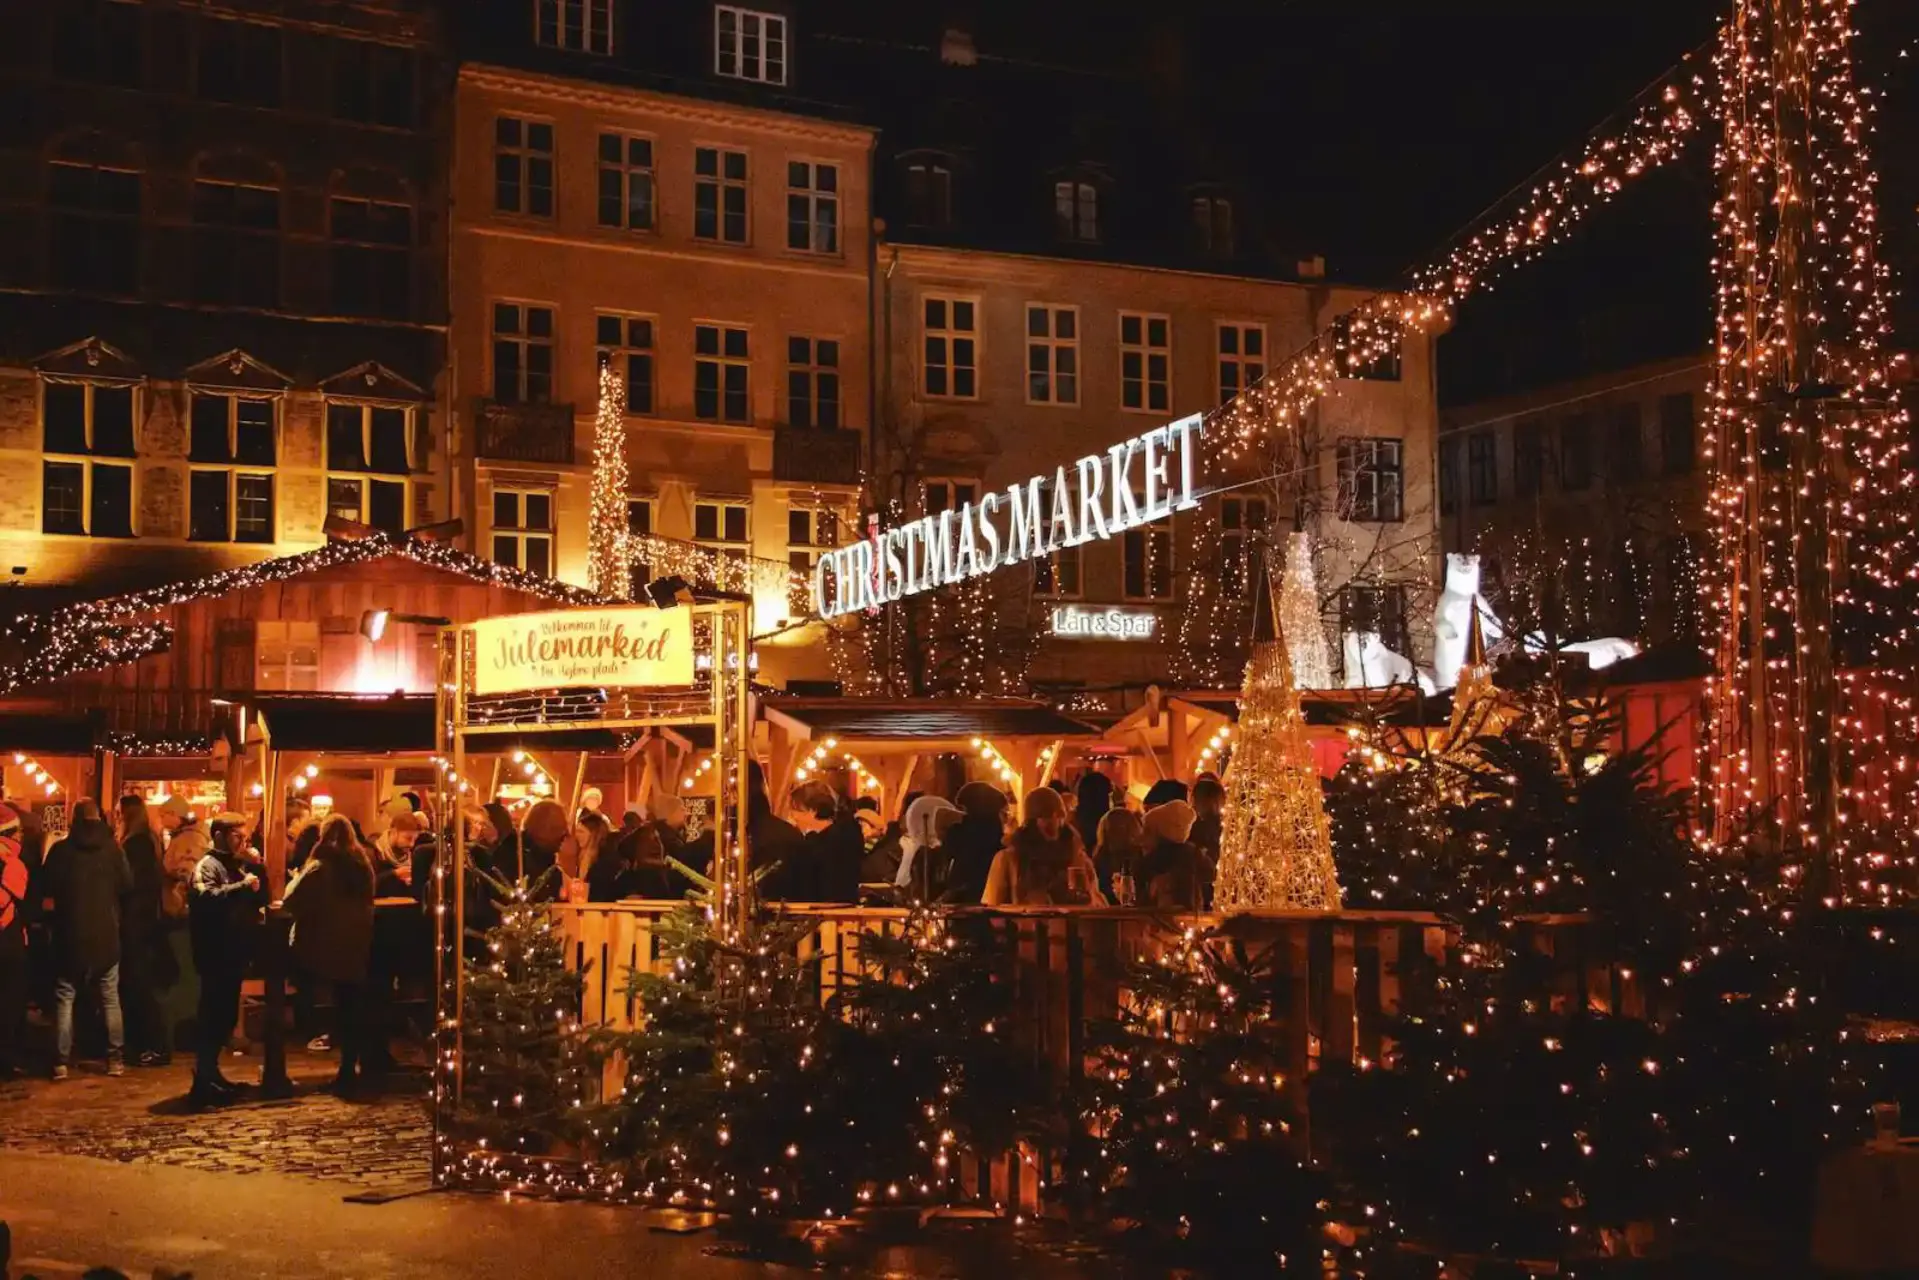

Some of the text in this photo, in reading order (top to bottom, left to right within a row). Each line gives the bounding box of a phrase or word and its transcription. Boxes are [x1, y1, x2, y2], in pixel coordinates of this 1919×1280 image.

[816, 412, 1204, 620] CHRISTMAS MARKET
[493, 623, 672, 671] Julemarked
